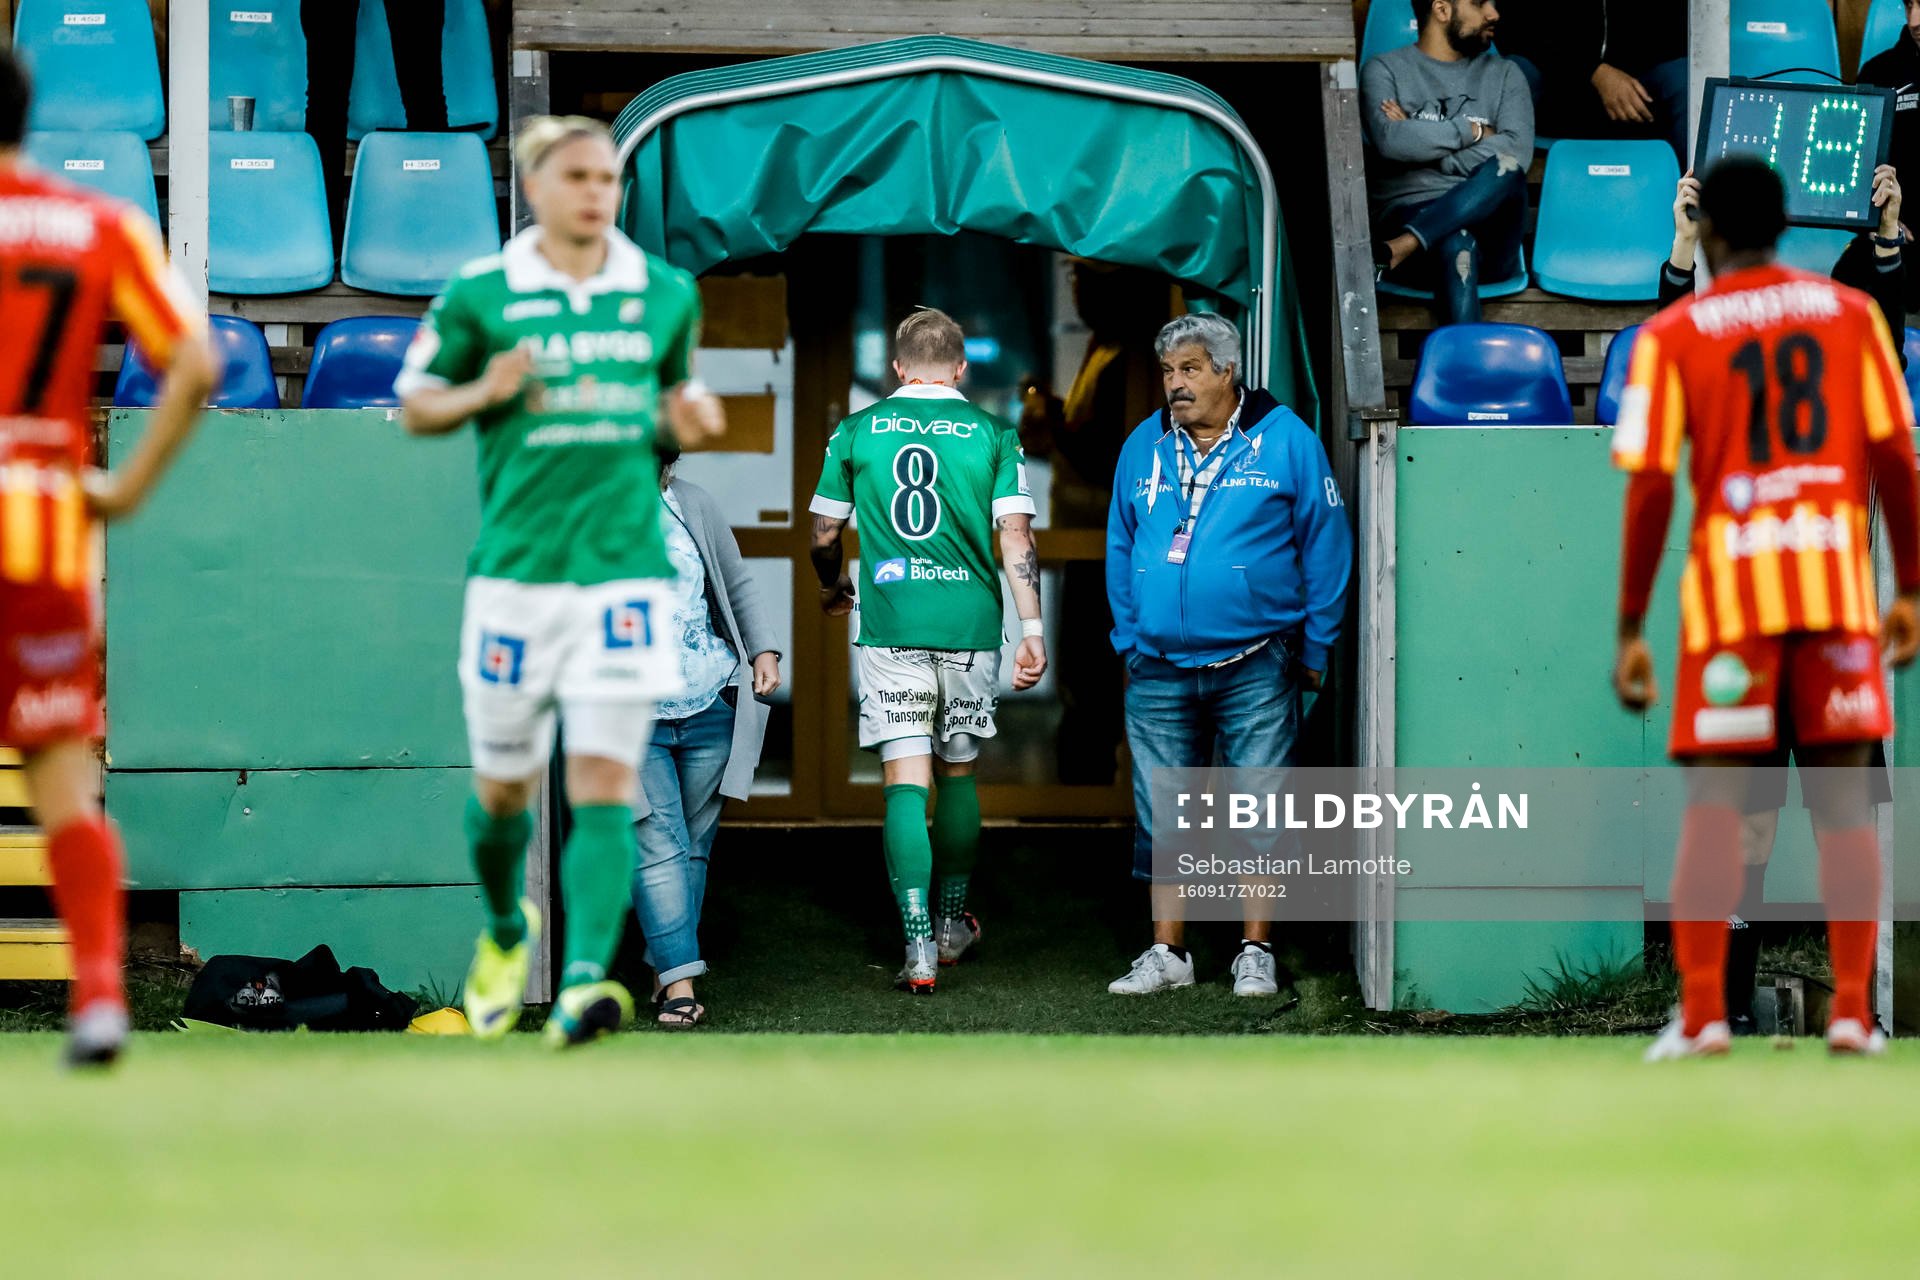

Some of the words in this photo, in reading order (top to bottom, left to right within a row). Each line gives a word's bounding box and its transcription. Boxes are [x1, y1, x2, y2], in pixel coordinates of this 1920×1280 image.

[1730, 332, 1829, 466] 18
[872, 412, 974, 438] biovac
[1248, 476, 1280, 489] TEAM
[890, 443, 941, 541] 8
[1324, 476, 1345, 507] 8
[910, 556, 933, 565] Bohus
[910, 565, 970, 581] BioTech
[885, 709, 930, 726] Transport
[974, 716, 988, 728] AB
